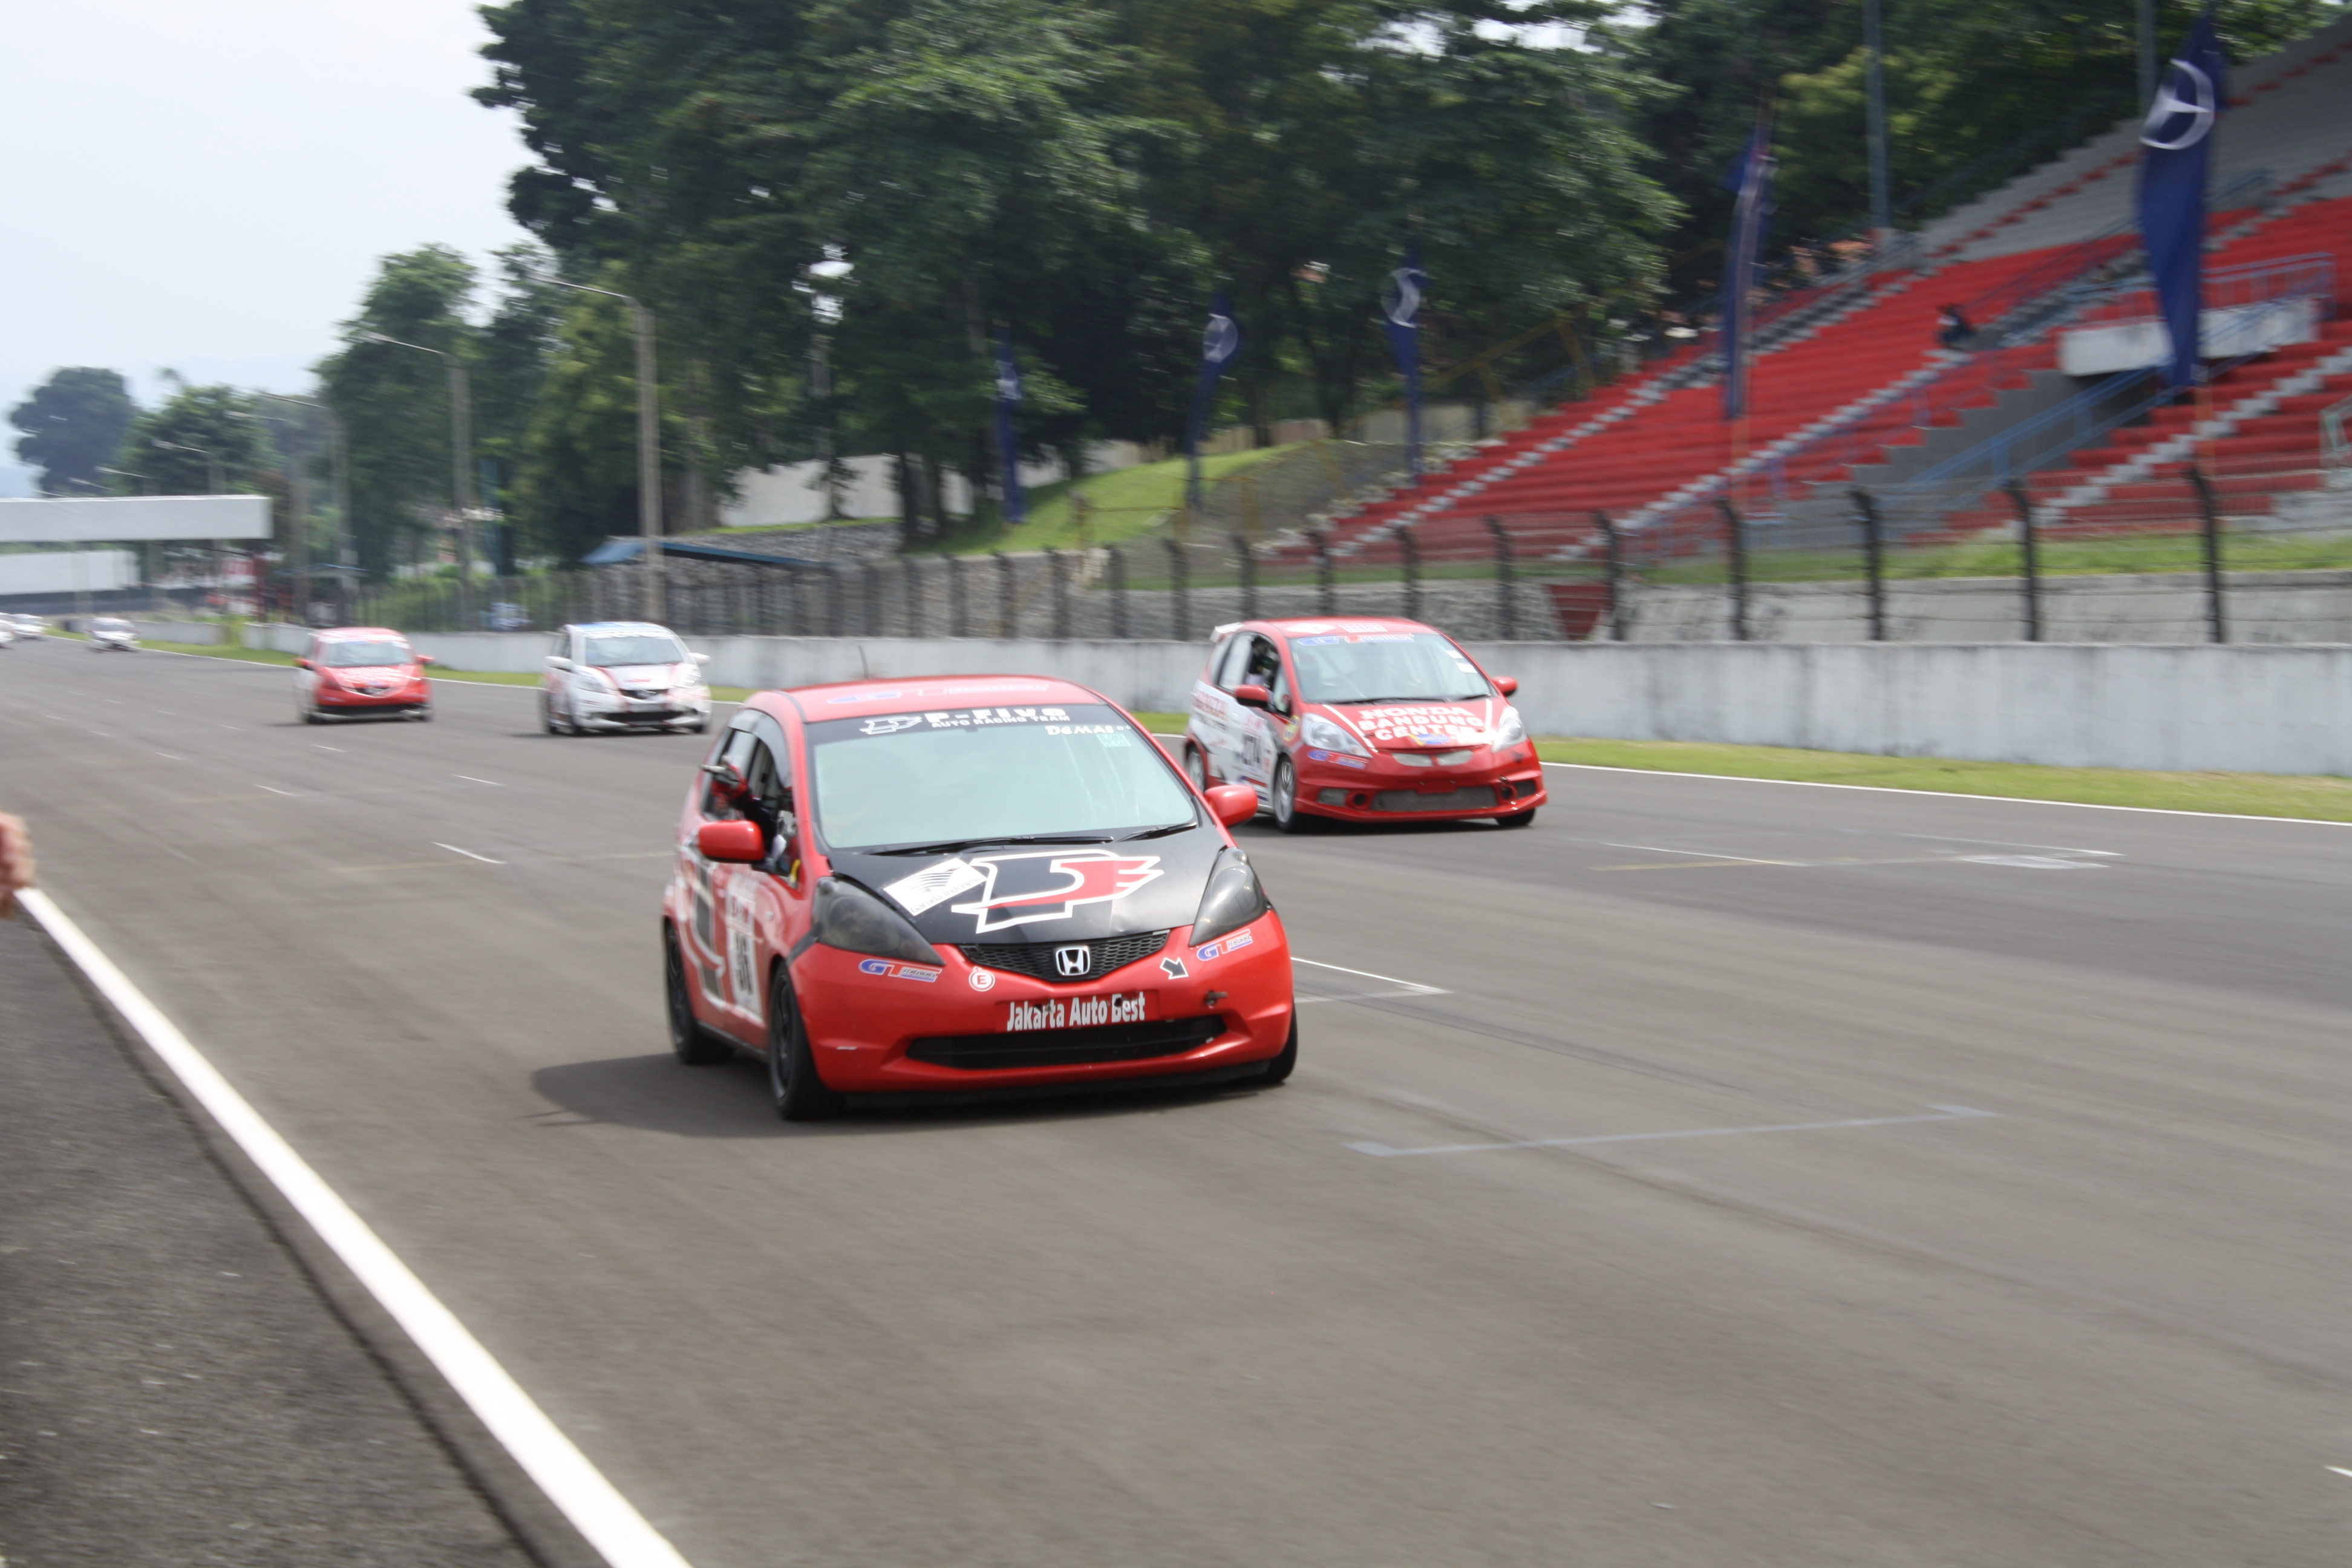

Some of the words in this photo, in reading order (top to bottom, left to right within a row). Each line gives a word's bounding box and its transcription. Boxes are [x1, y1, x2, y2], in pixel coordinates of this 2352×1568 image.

[1359, 707, 1475, 719] HONDA
[932, 719, 970, 728] AUTO
[1358, 715, 1484, 731] BANDUNG
[1374, 724, 1477, 740] CENTER
[910, 893, 943, 913] Garuda
[944, 875, 985, 897] Indonesia
[1007, 999, 1065, 1032] Jakarta
[1069, 995, 1108, 1027] Auto
[1111, 991, 1146, 1023] Best
